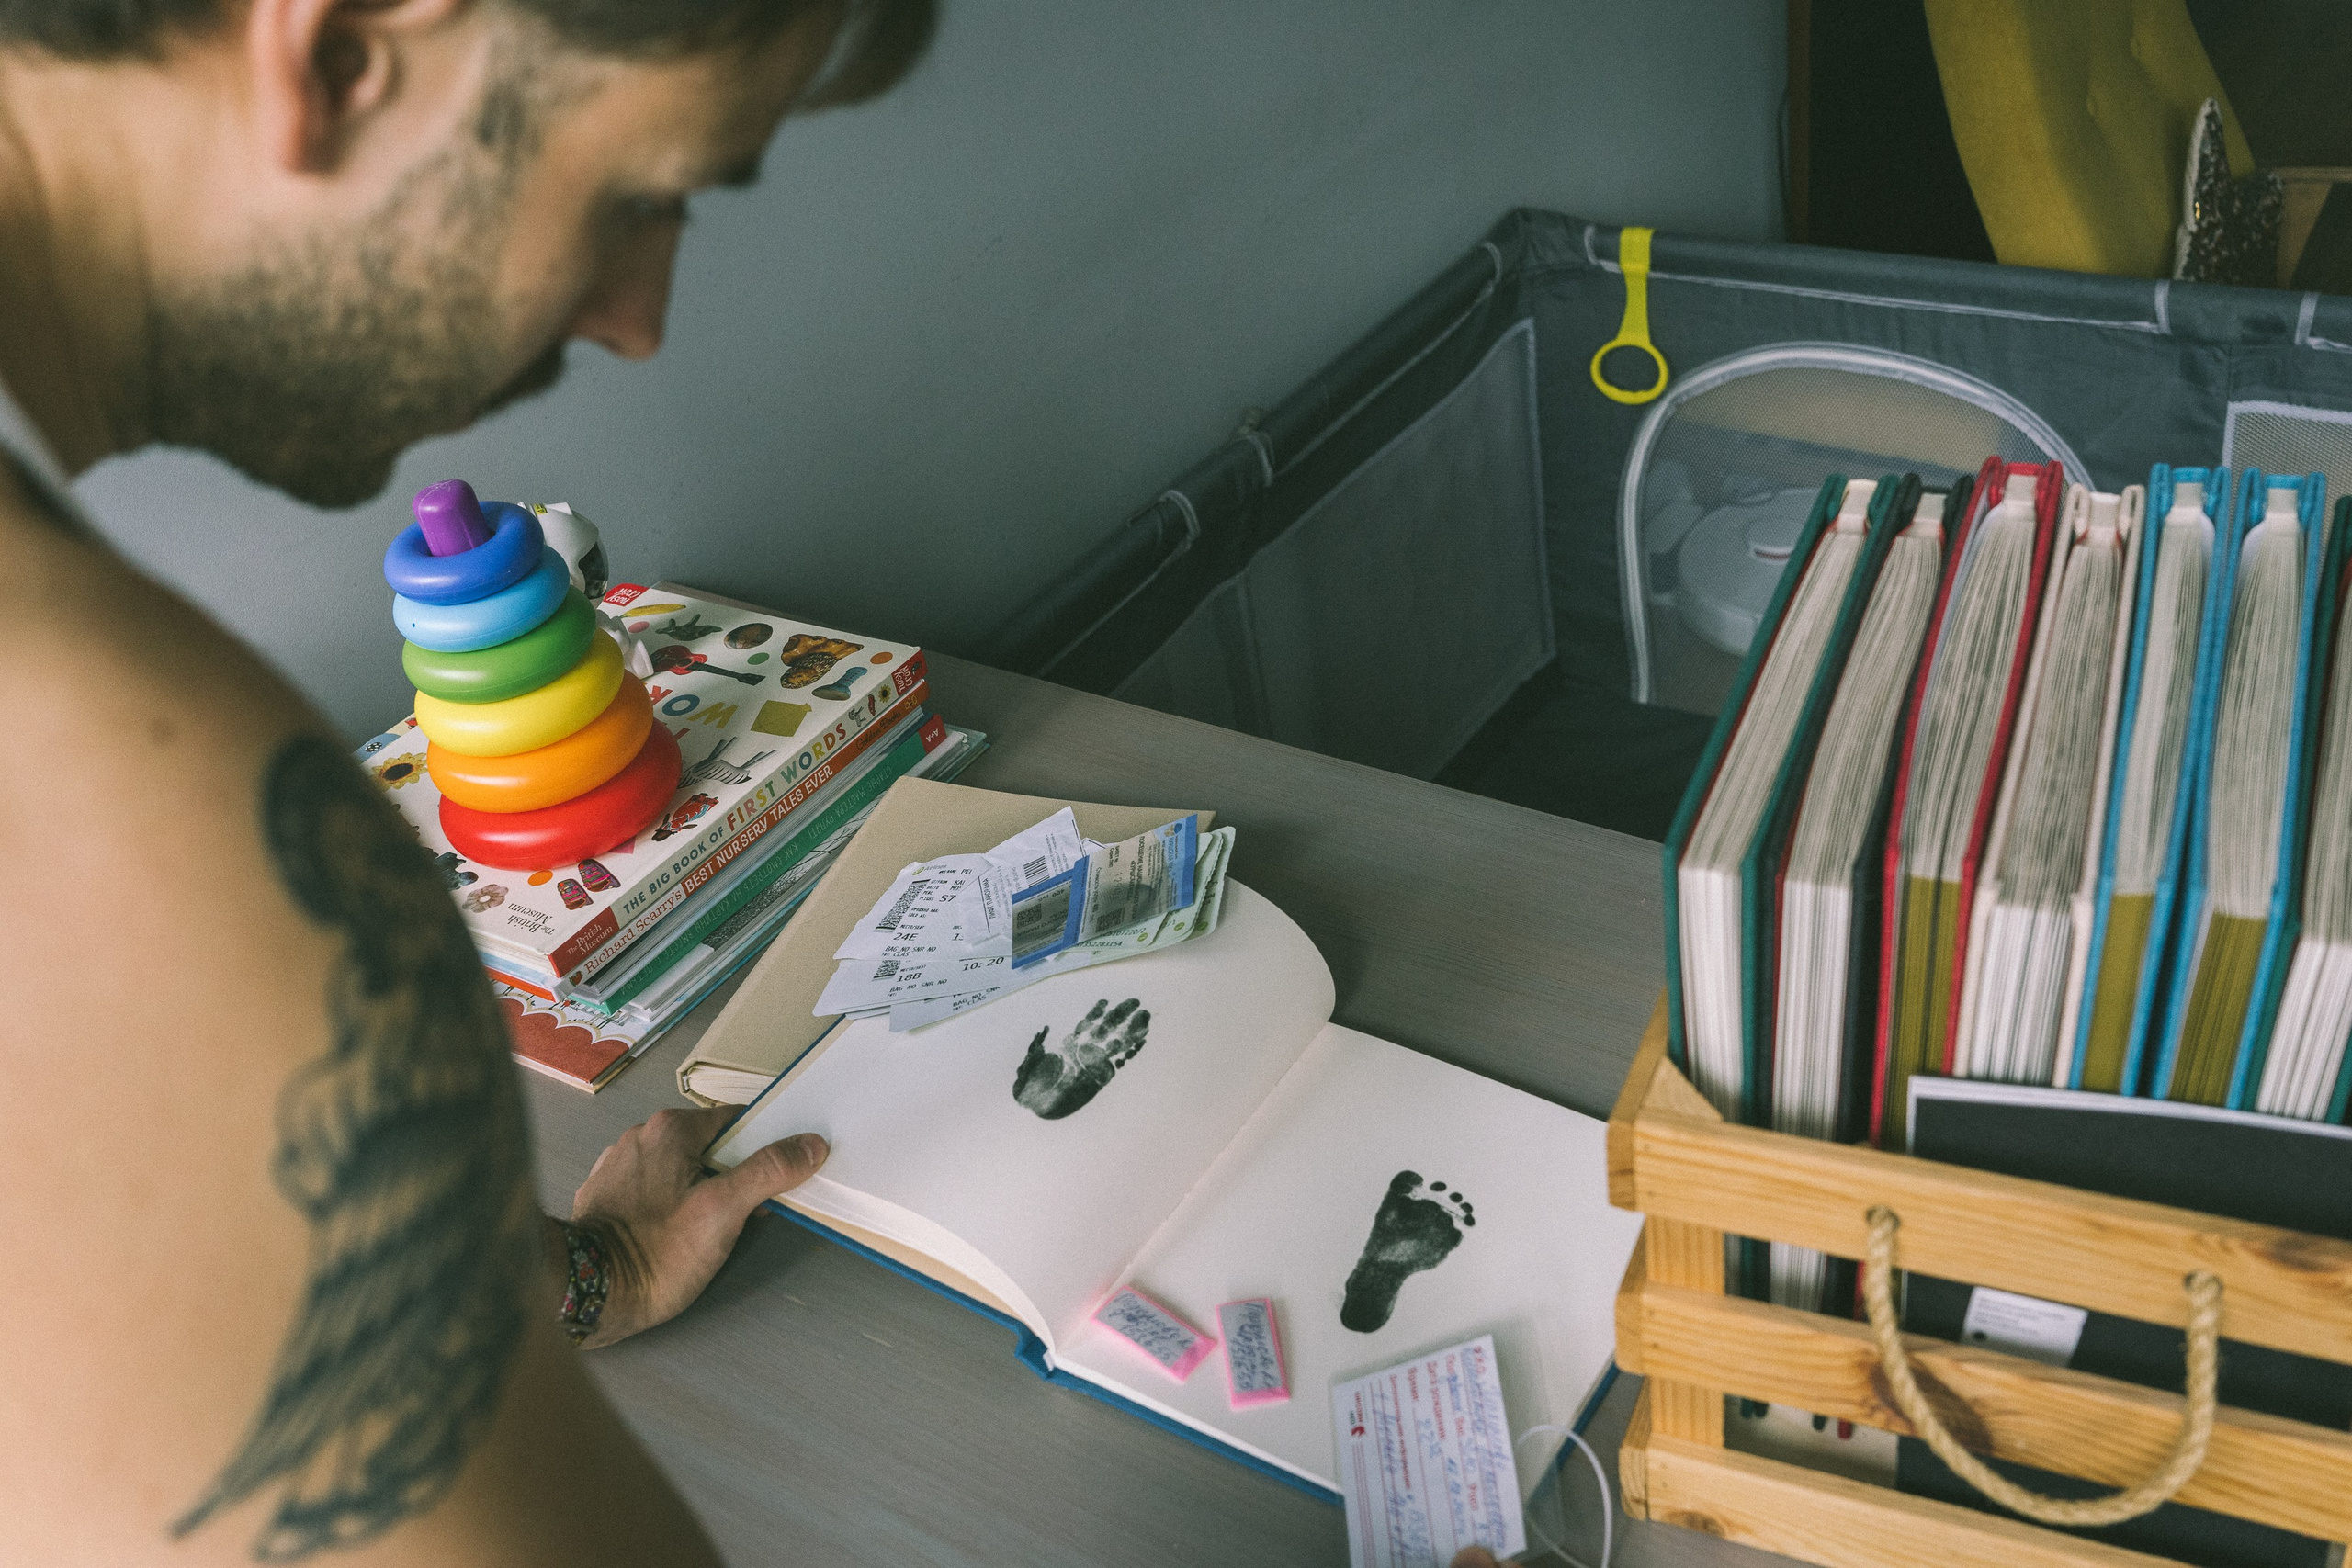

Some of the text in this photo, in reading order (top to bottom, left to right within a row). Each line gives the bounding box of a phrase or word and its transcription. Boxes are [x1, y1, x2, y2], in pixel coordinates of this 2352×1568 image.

[855, 727, 881, 750] Golden
[832, 786, 868, 818] МАСТЕРА
[623, 722, 847, 915] THE BIG BOOK OF FIRST WORDS
[782, 840, 800, 860] КАК
[583, 764, 833, 975] Richard Scarry's BEST NURSERY TALES EVER
[741, 854, 784, 892] СМОТРЕТЬ
[729, 887, 743, 903] НА
[939, 895, 956, 903] S7
[507, 903, 554, 925] Museum
[507, 914, 555, 935] The British
[692, 897, 731, 933] КАРТИНЫ
[567, 923, 603, 955] The British
[580, 925, 613, 956] Museum
[893, 932, 919, 941] 24E
[986, 956, 1005, 967] 20
[897, 972, 922, 982] 18B
[953, 998, 967, 1007] BAG
